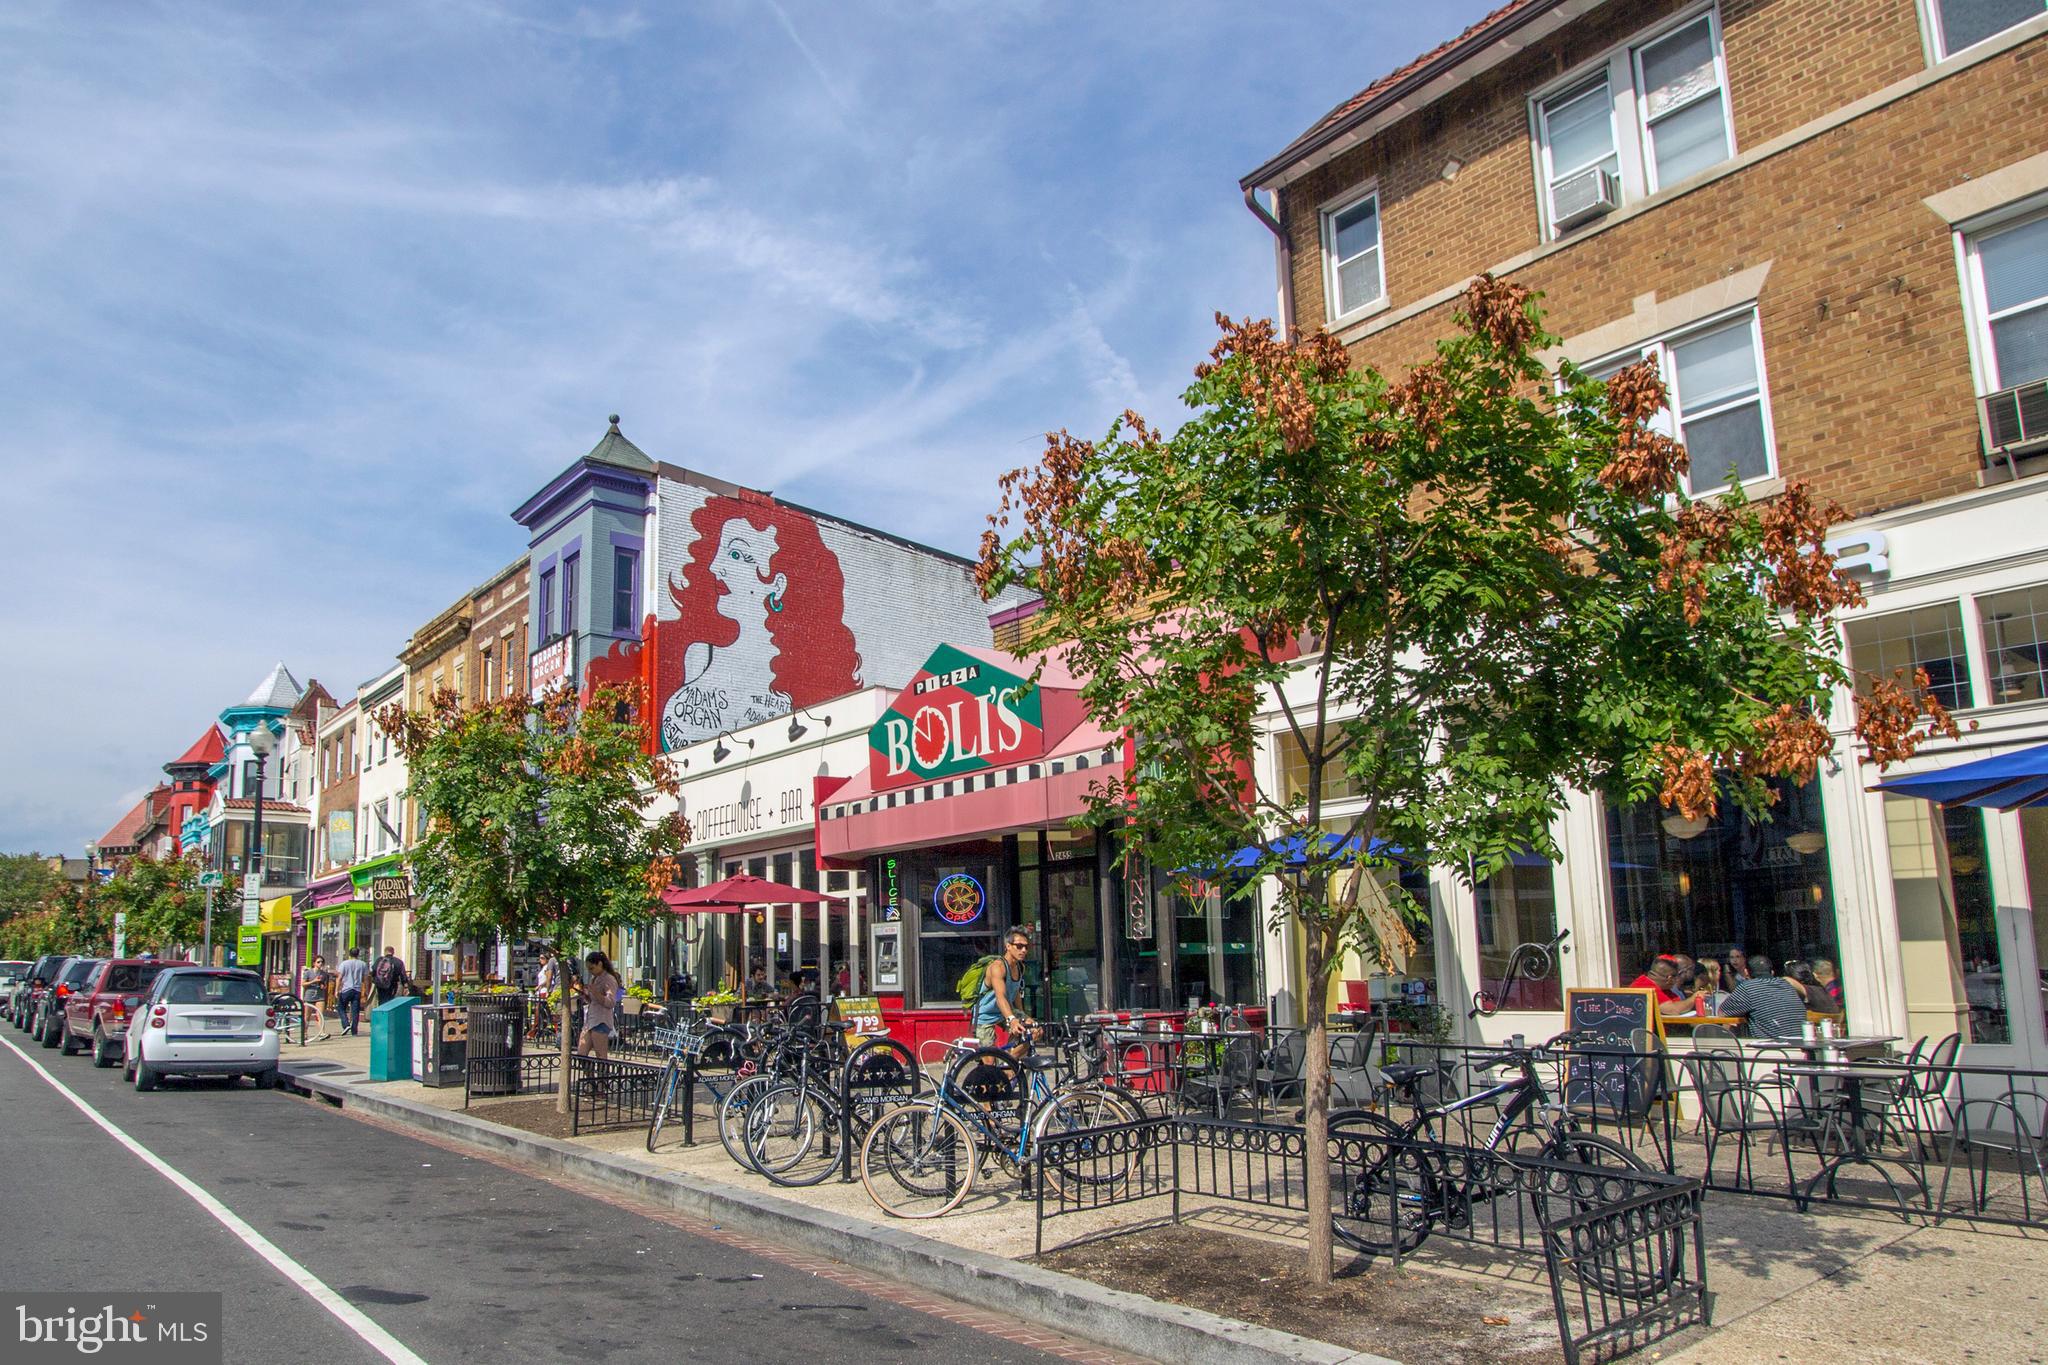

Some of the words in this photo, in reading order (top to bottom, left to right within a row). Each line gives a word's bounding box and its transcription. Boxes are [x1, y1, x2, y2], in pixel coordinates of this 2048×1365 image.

[534, 656, 561, 680] ORGAN
[915, 666, 979, 695] PIZZA
[750, 695, 764, 705] THE
[764, 694, 791, 713] HEART
[674, 702, 722, 729] ORGAN
[884, 685, 1023, 777] BOLI'S
[696, 797, 762, 841] COFFEEHOUSE
[781, 788, 804, 825] BAR
[887, 859, 899, 907] SLICE
[941, 876, 975, 890] PIZZA
[374, 890, 408, 900] ORGAN
[945, 910, 977, 922] OPEN
[1577, 998, 1602, 1012] THE
[880, 1095, 908, 1103] MORGAN
